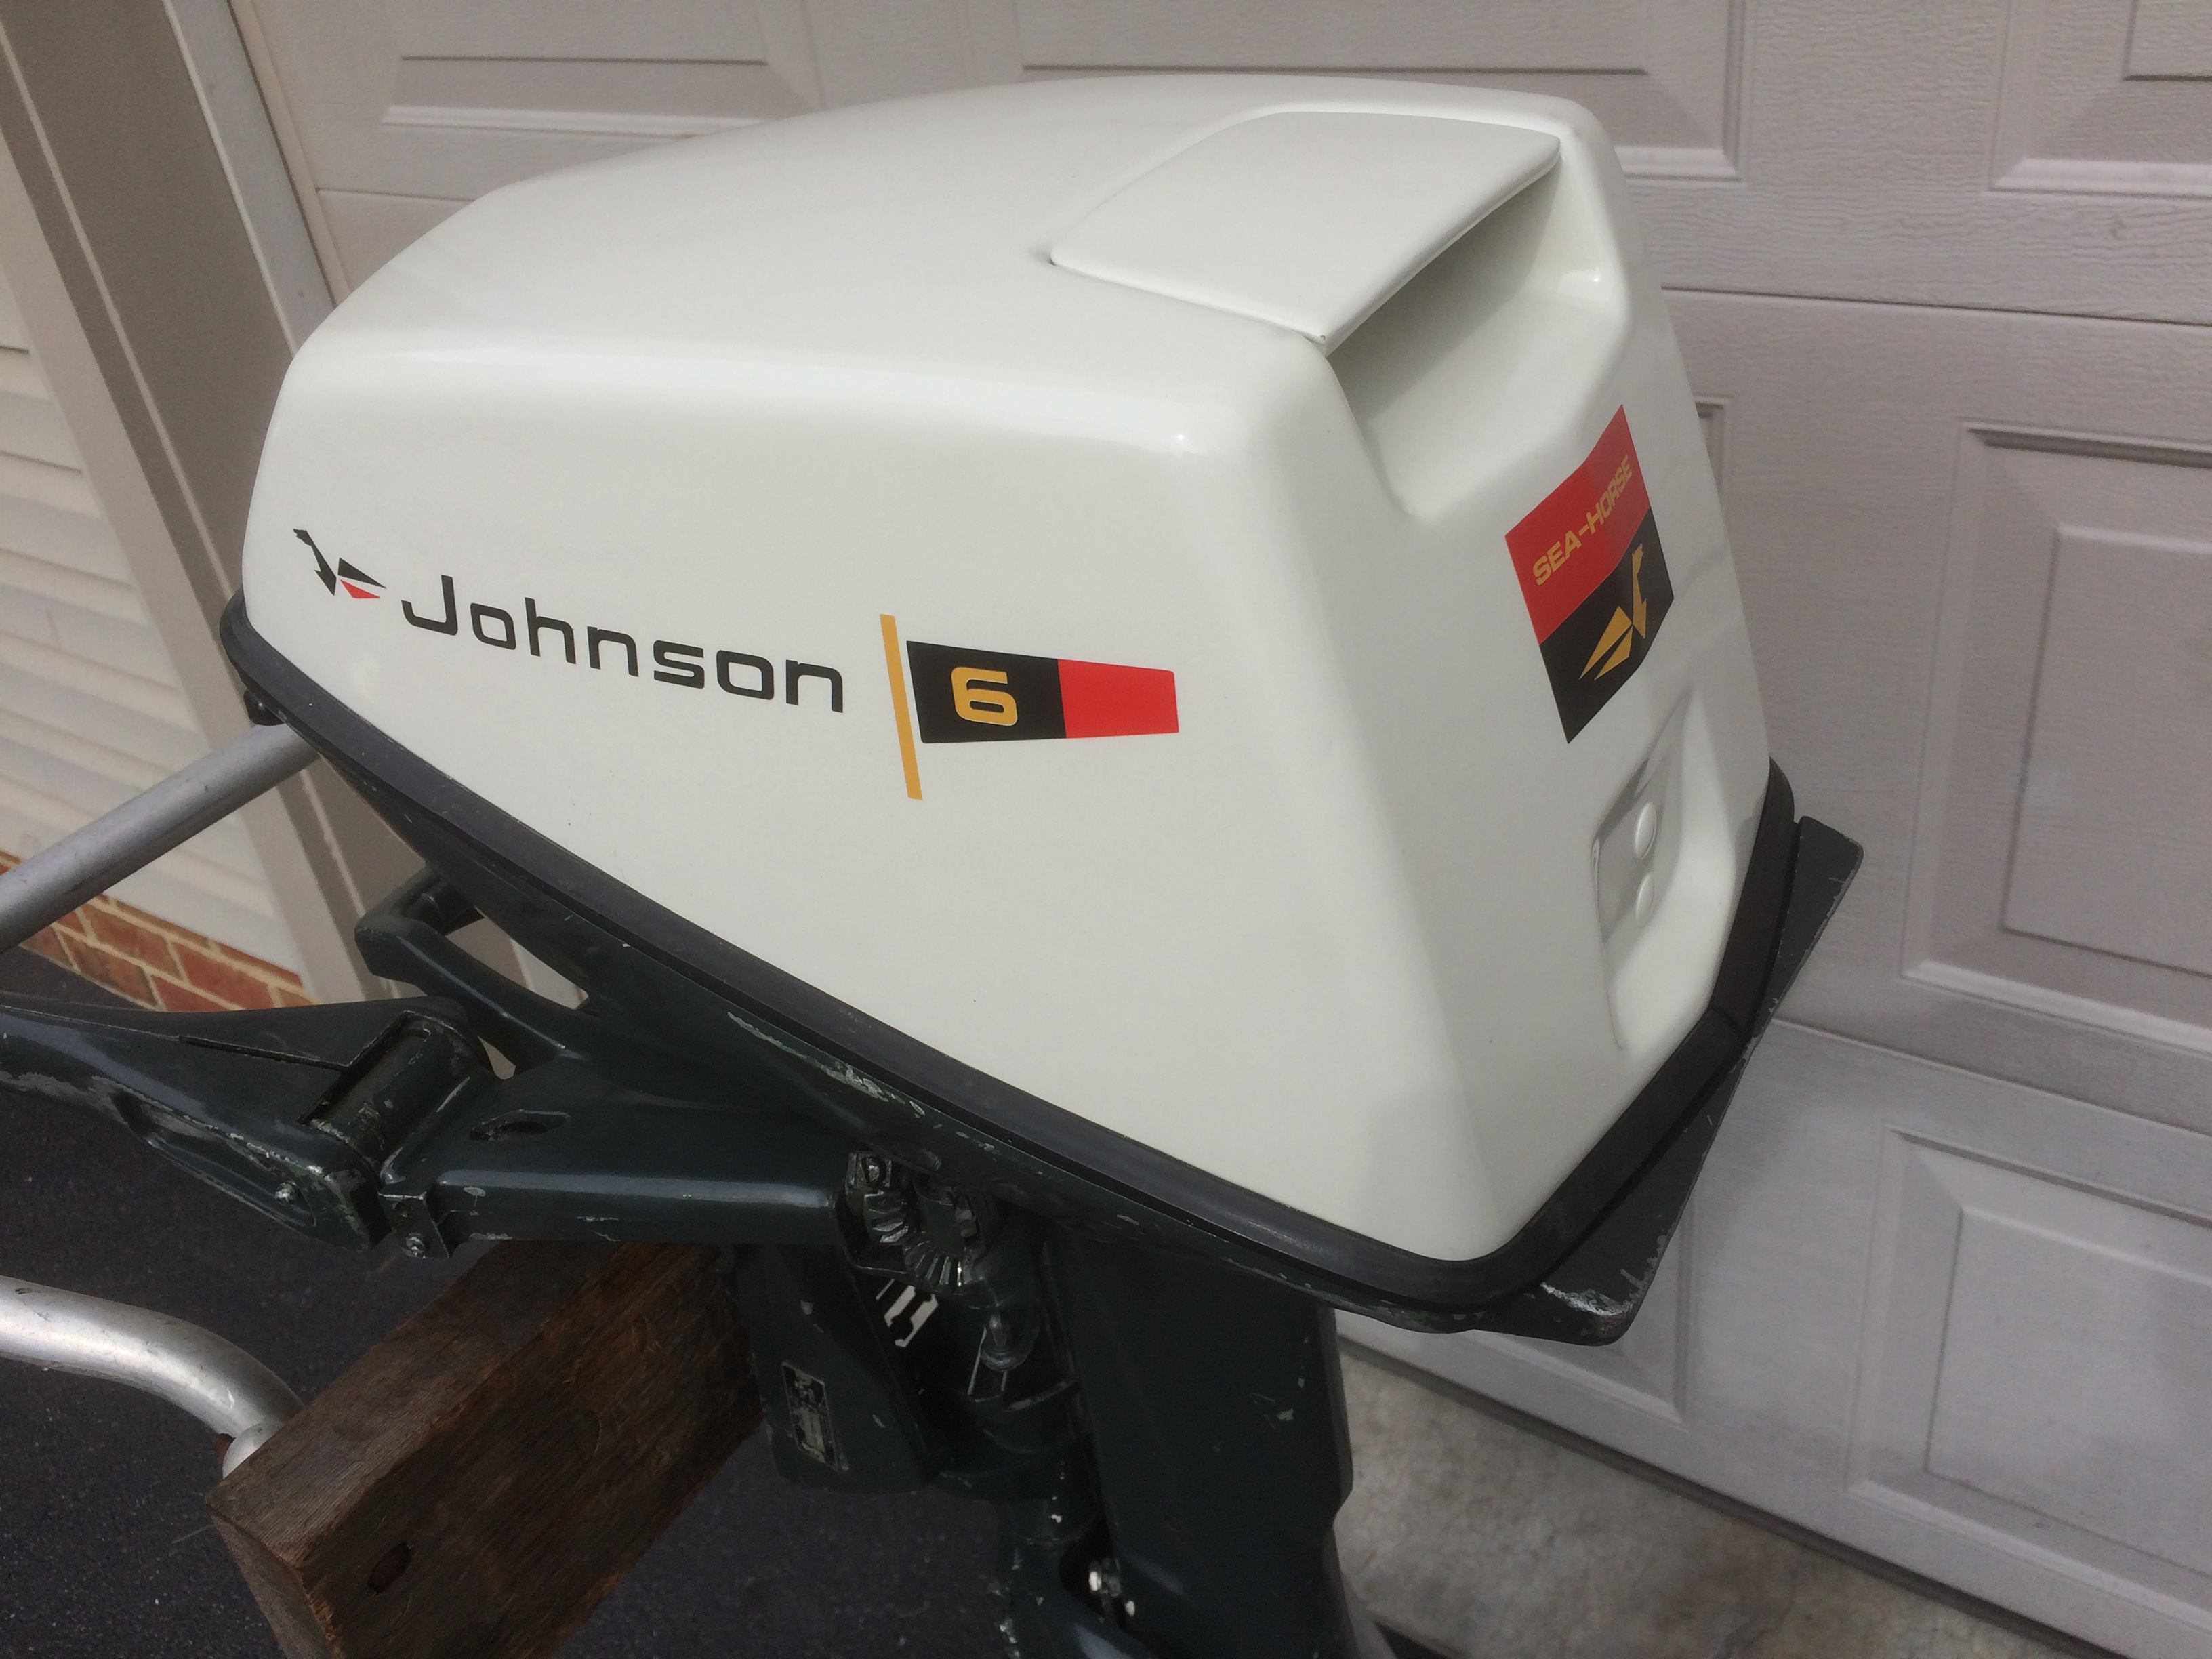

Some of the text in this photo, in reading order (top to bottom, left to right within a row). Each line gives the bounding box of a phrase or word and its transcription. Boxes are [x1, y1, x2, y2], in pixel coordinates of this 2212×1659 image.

[1532, 455, 1633, 586] SEA-HORSE
[401, 574, 844, 713] Johnson
[951, 666, 1018, 726] 6
